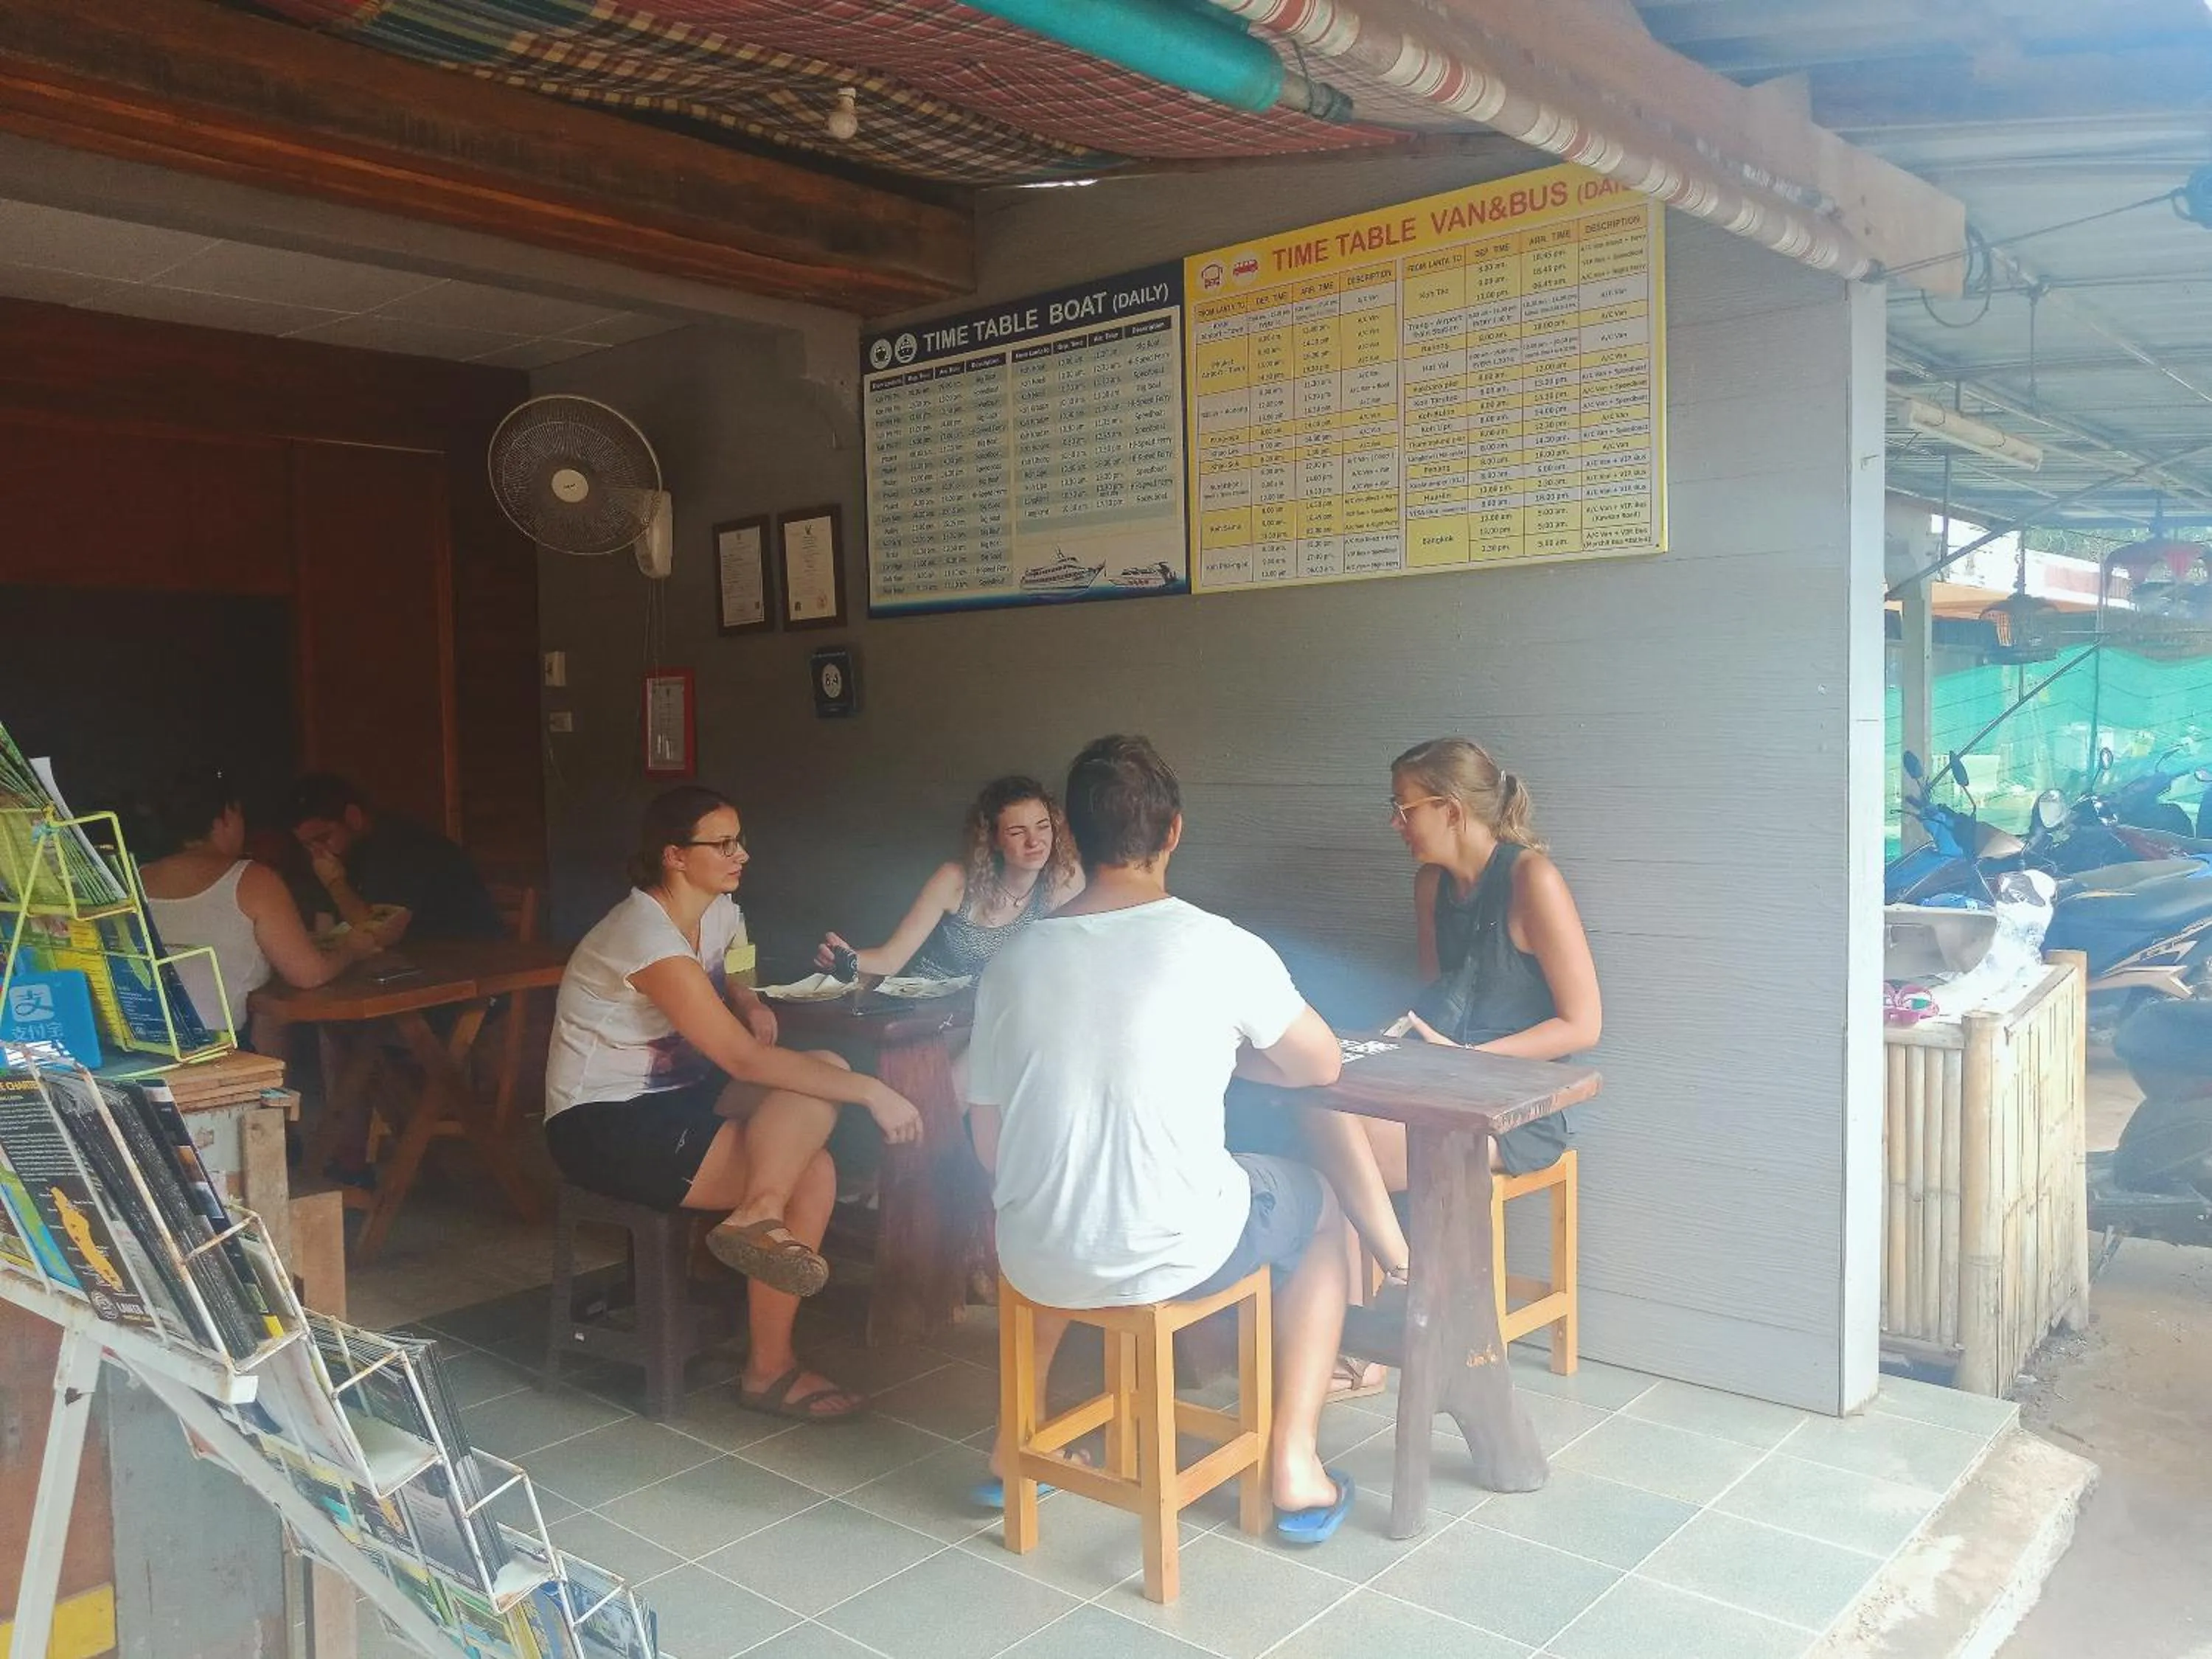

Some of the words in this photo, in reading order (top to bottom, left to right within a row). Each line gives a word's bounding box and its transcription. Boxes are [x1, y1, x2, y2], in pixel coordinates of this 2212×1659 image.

[1273, 238, 1329, 271] TIME
[1336, 219, 1416, 254] TABLE
[1430, 181, 1568, 234] VAN&BUS
[1585, 215, 1639, 233] DESCRIPTION
[1551, 229, 1570, 240] TIME
[1347, 269, 1391, 285] DESCRIPTION
[1318, 282, 1333, 291] TIME
[924, 324, 969, 353] TIME
[973, 308, 1039, 342] TABLE
[1049, 292, 1106, 326] BOAT
[1113, 283, 1169, 313] (DAILY)
[11, 1022, 63, 1040] 支付宝
